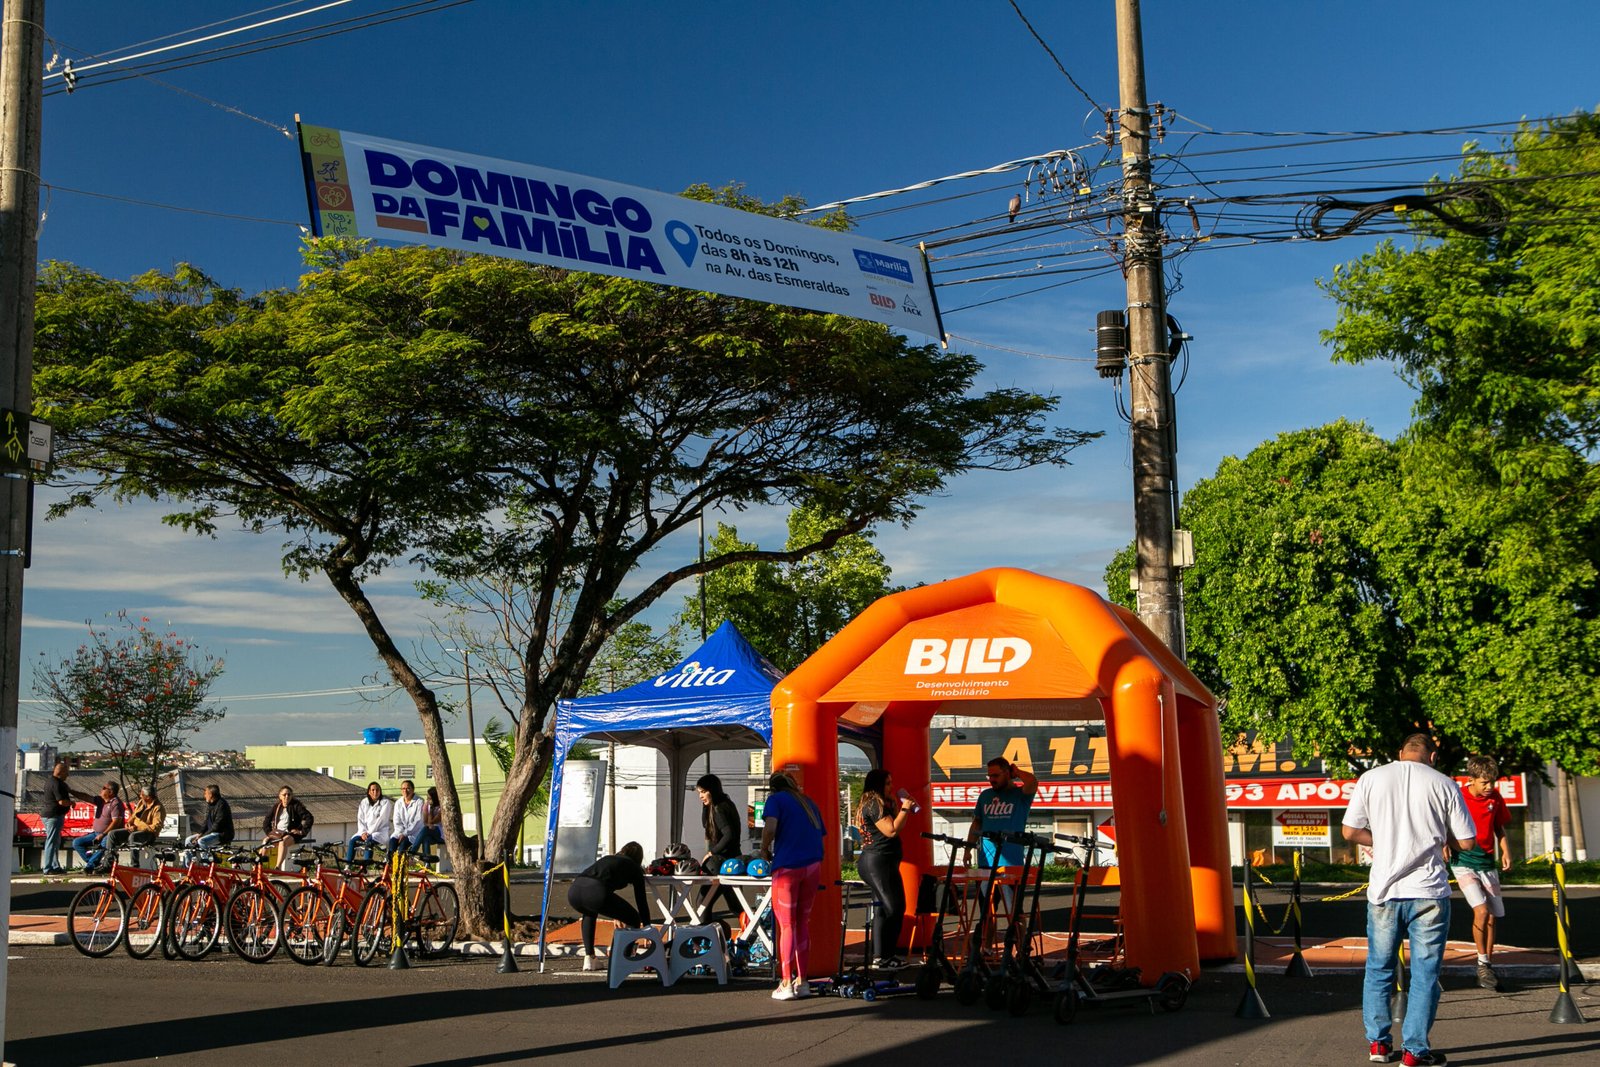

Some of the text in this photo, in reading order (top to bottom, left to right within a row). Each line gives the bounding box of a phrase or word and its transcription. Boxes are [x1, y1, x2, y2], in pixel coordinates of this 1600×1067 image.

[364, 149, 653, 233] DOMINGO
[372, 192, 667, 275] DA FAMÍLIA
[695, 225, 840, 266] Todos os Domingos,
[701, 242, 800, 272] das 8h às 12h
[705, 262, 850, 296] na Av. das Esmeraldas
[869, 292, 896, 309] BILD
[902, 305, 922, 317] TACK
[904, 637, 1032, 675] BILD
[654, 662, 736, 688] vitta
[916, 679, 1009, 689] Desenvolvimento
[931, 688, 989, 697] Imobiliário
[1001, 737, 1034, 774] A
[1049, 736, 1110, 775] 1.1
